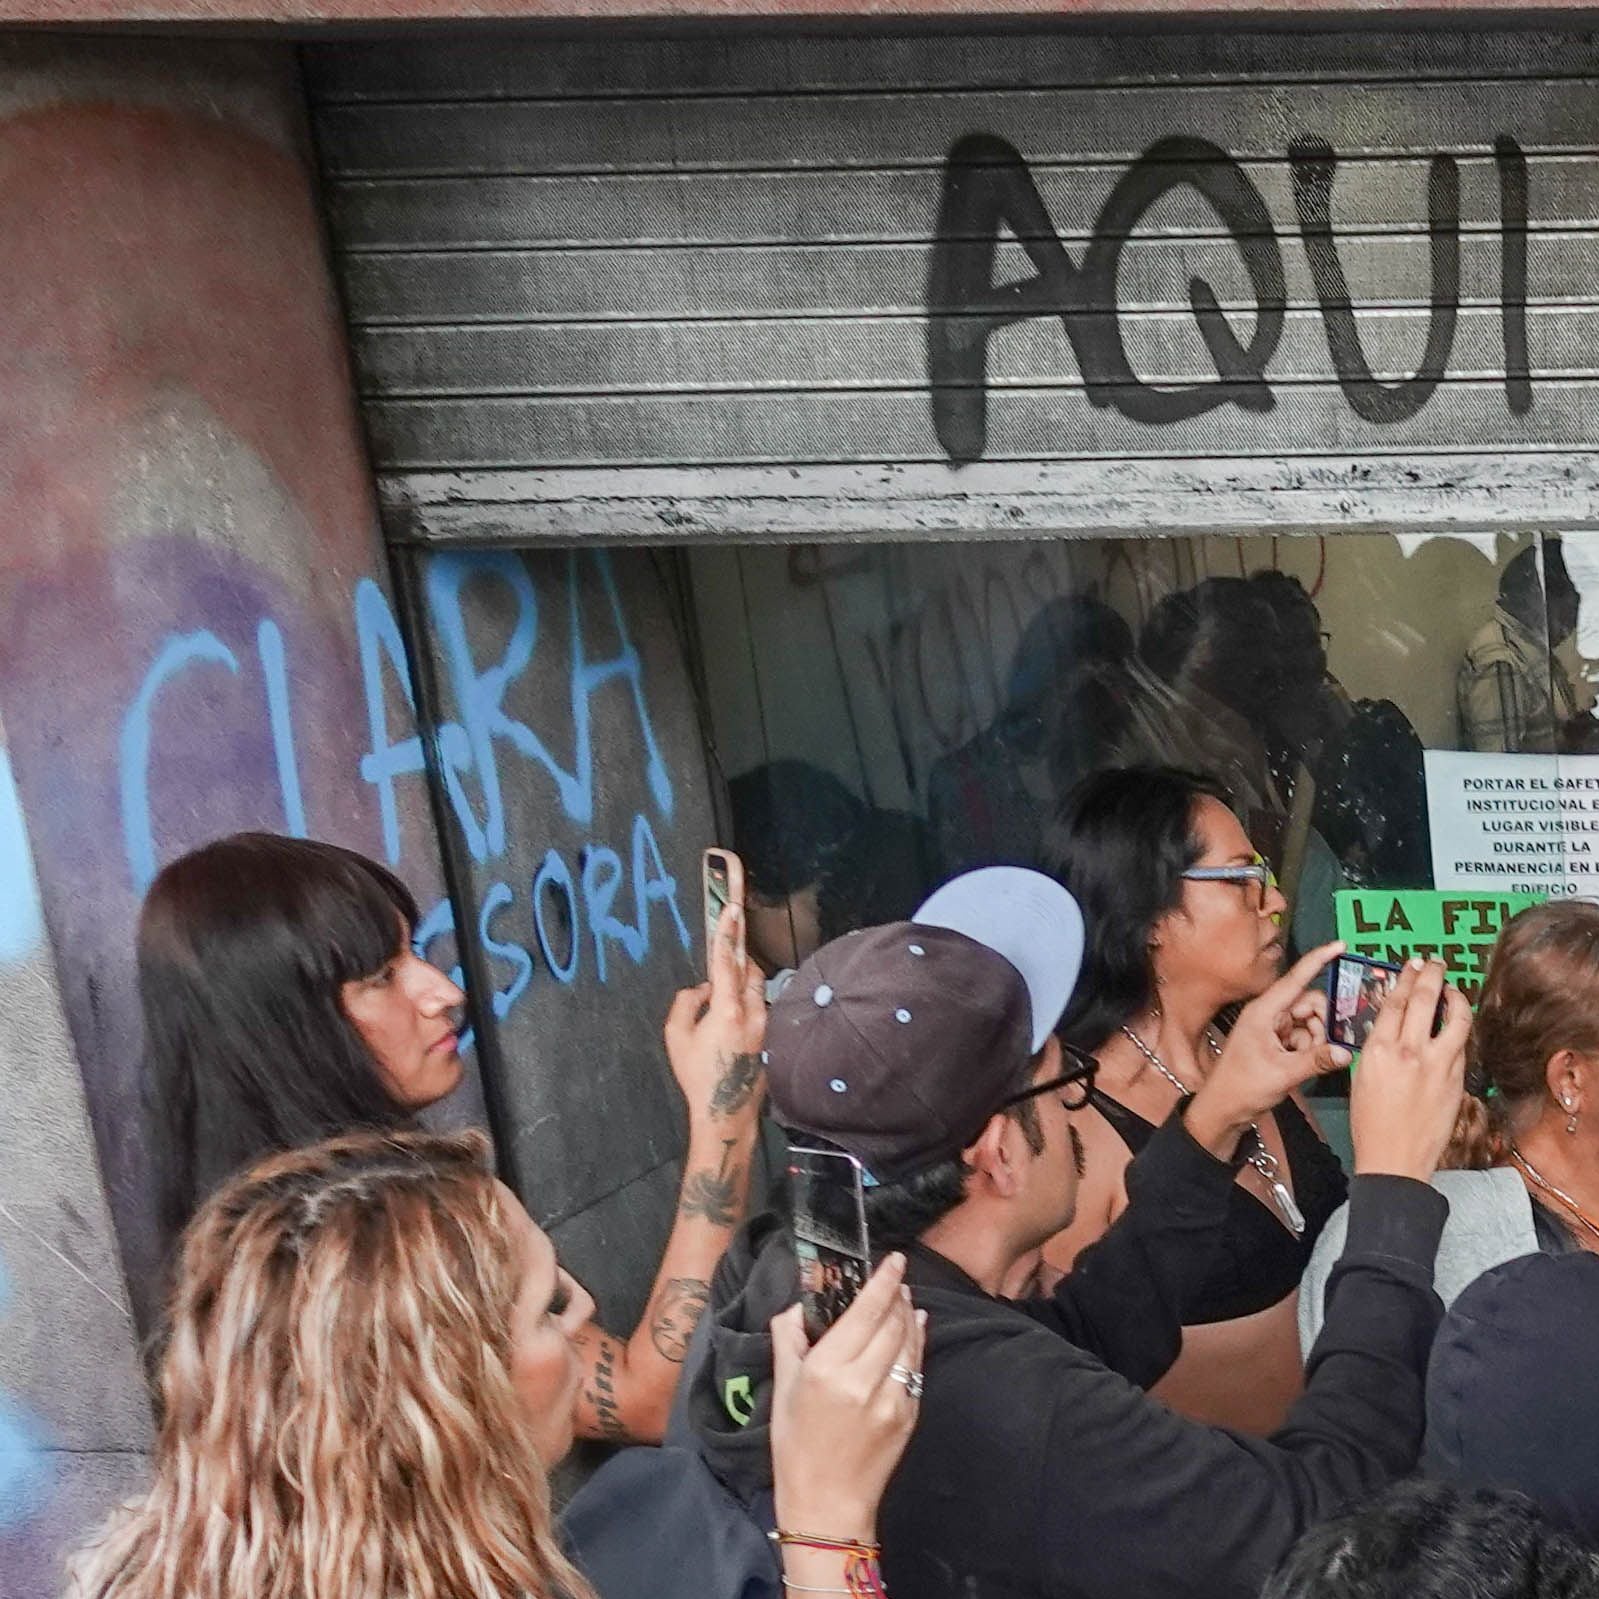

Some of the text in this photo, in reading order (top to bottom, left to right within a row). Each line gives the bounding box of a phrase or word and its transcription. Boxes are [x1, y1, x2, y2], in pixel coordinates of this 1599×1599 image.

[926, 131, 1534, 471] AQUI
[1463, 778, 1525, 790] PORTAR
[1530, 778, 1549, 790] EL
[1466, 799, 1584, 811] INSTITUCIONAL
[1482, 820, 1599, 832] LUGAR VISIBLE
[1493, 841, 1591, 853] DURANTE LA
[1454, 862, 1564, 874] PERMANENCIA
[1570, 862, 1590, 874] EN
[1511, 883, 1578, 895] EDIFICIO
[1353, 898, 1537, 935] LA FIL
